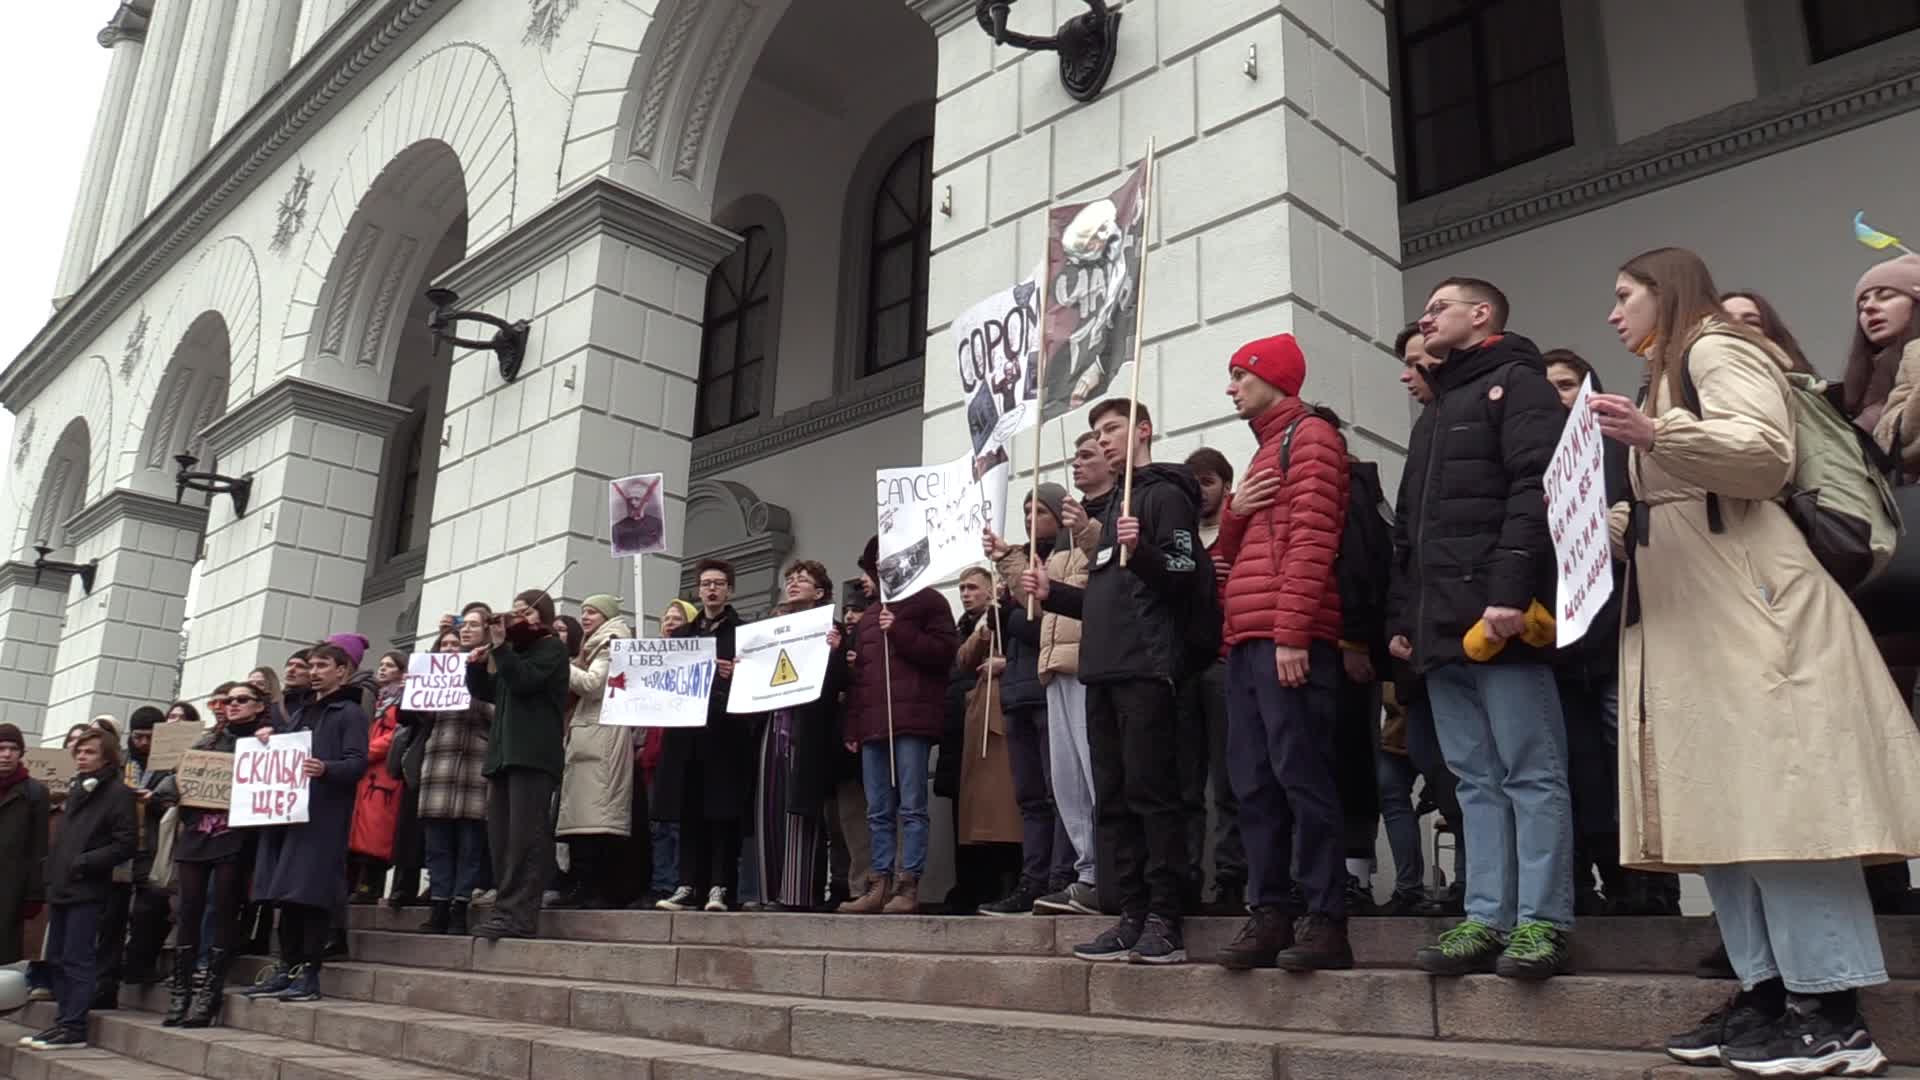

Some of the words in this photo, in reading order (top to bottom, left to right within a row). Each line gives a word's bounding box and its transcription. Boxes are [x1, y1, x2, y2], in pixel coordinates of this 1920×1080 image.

[613, 640, 622, 652] В
[431, 651, 461, 674] NO
[639, 654, 664, 667] БЕЗ
[252, 789, 298, 821] ЩЕ?
